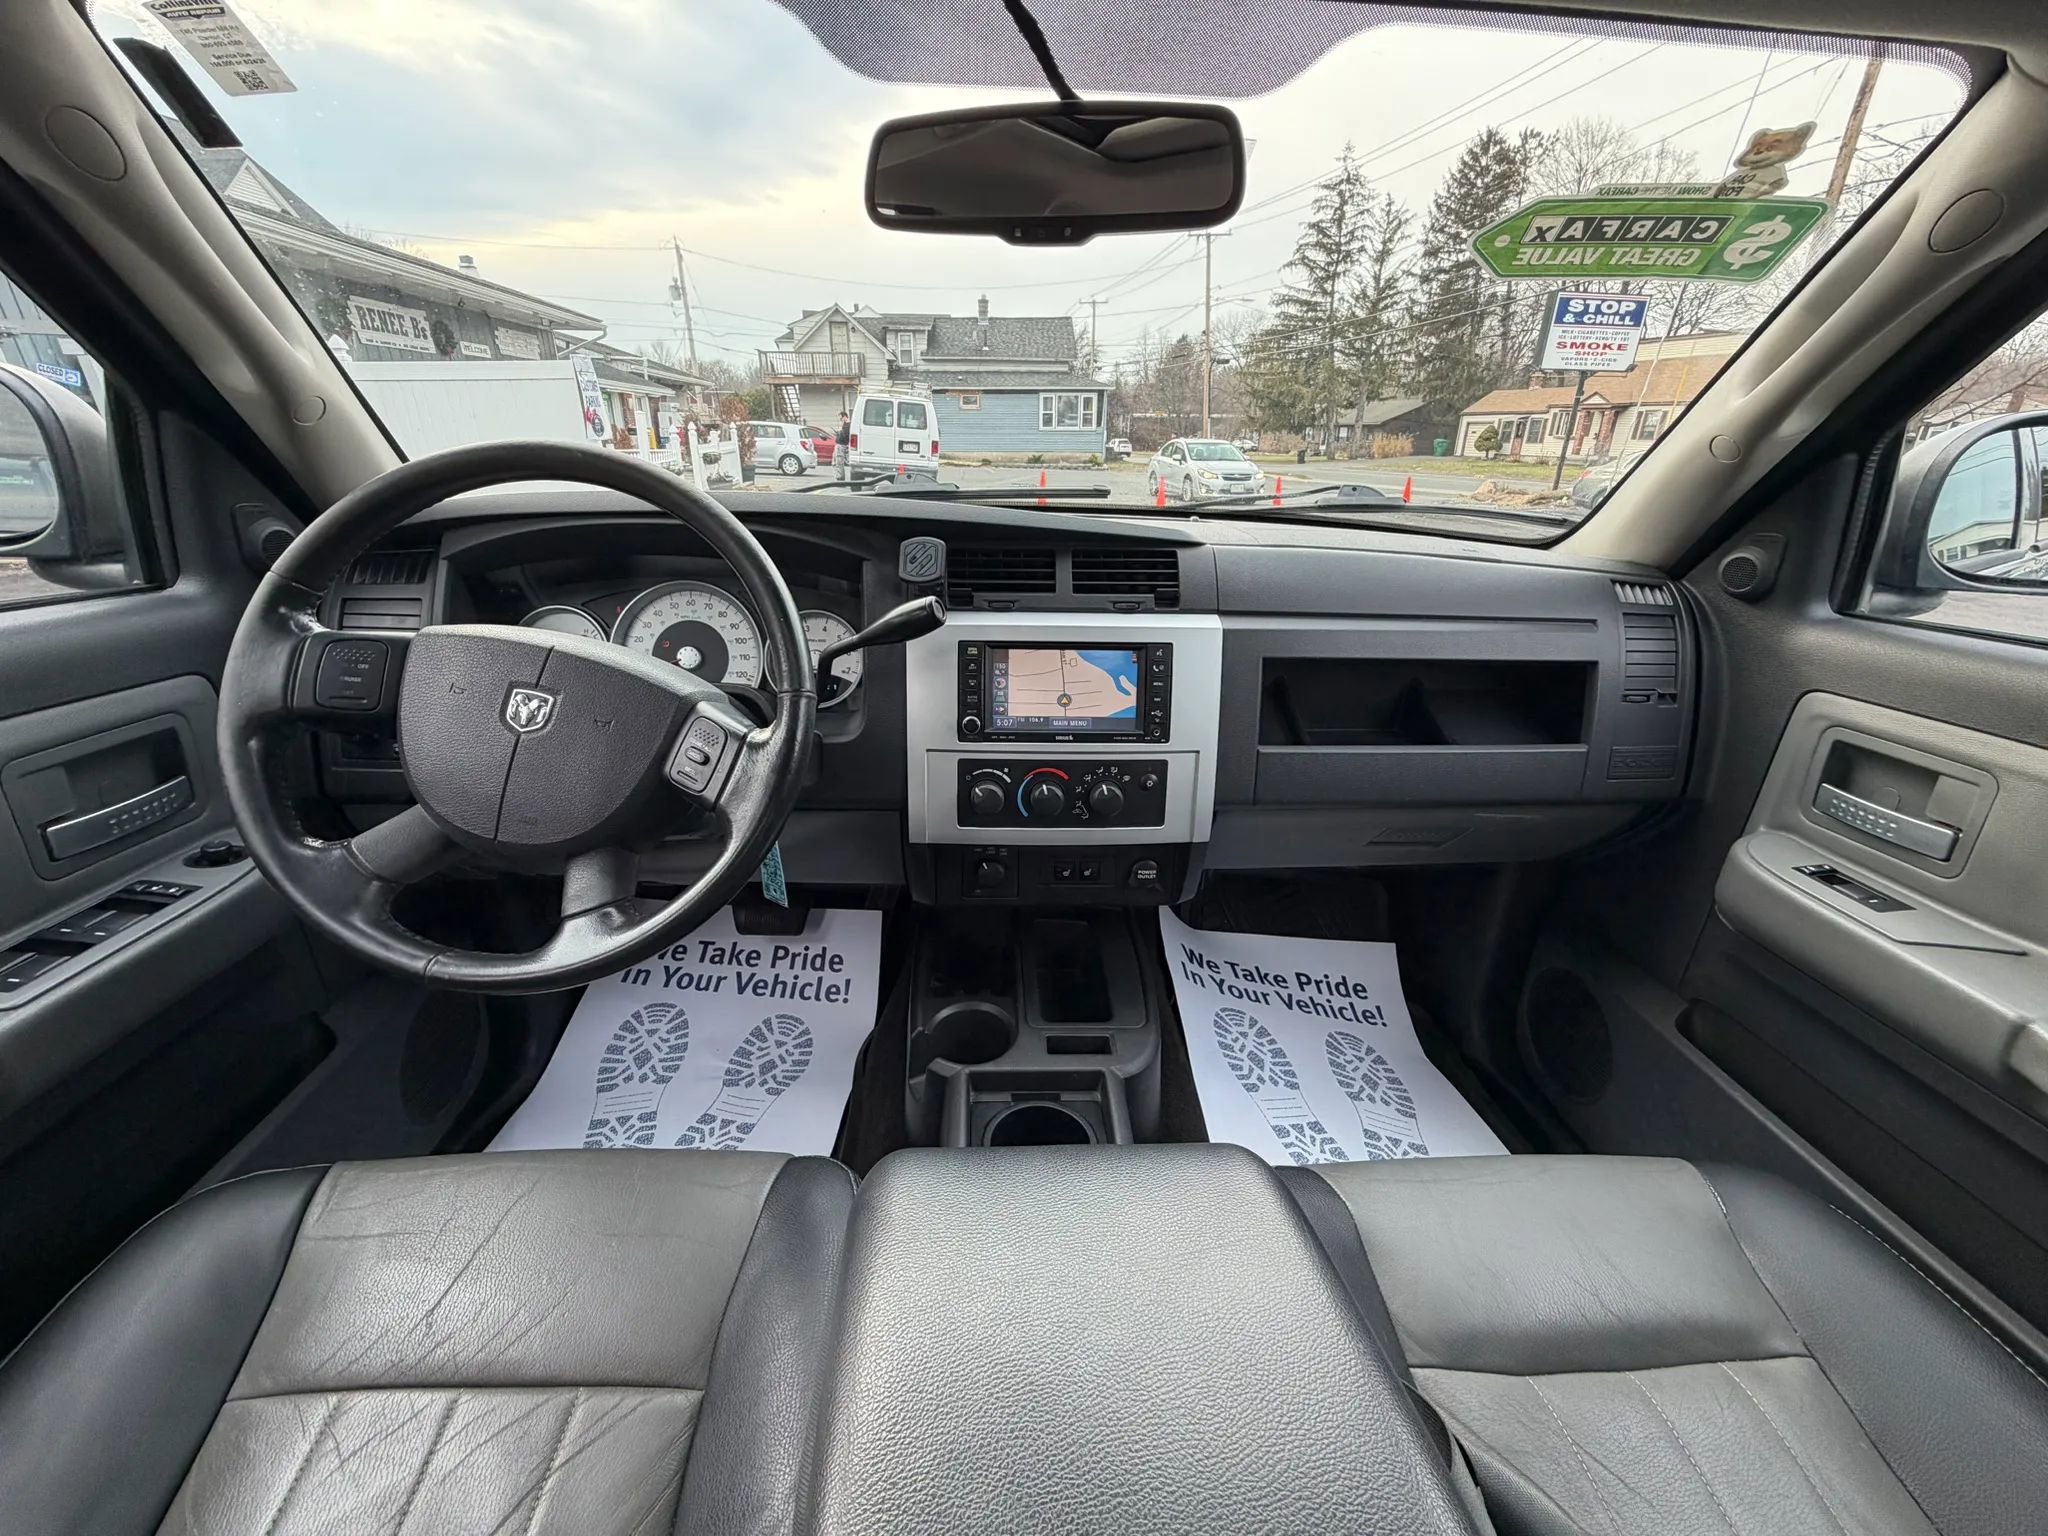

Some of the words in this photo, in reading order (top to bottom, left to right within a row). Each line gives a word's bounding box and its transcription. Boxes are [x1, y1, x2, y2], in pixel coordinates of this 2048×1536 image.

[1568, 299, 1636, 314] STOP
[1562, 312, 1576, 323] &
[1582, 313, 1635, 325] CHILL
[1556, 341, 1629, 351] SMOKE
[38, 364, 64, 377] CLOSED
[703, 602, 714, 610] 70
[652, 609, 663, 617] 40
[642, 621, 652, 629] 30
[729, 623, 740, 631] 90
[734, 637, 748, 645] 100
[739, 653, 751, 661] 110
[996, 719, 1013, 727] 5:07
[658, 943, 688, 962] e
[697, 940, 762, 968] Take
[770, 945, 844, 974] Pride
[1180, 943, 1221, 975] We
[1224, 960, 1290, 990] Take
[1294, 971, 1369, 1001] Pride
[620, 967, 652, 987] In
[662, 965, 728, 994] Your
[735, 971, 852, 1005] Vehicle!
[1180, 961, 1207, 990] In
[1208, 973, 1272, 1007] Your
[1273, 989, 1389, 1028] Vehicle!
